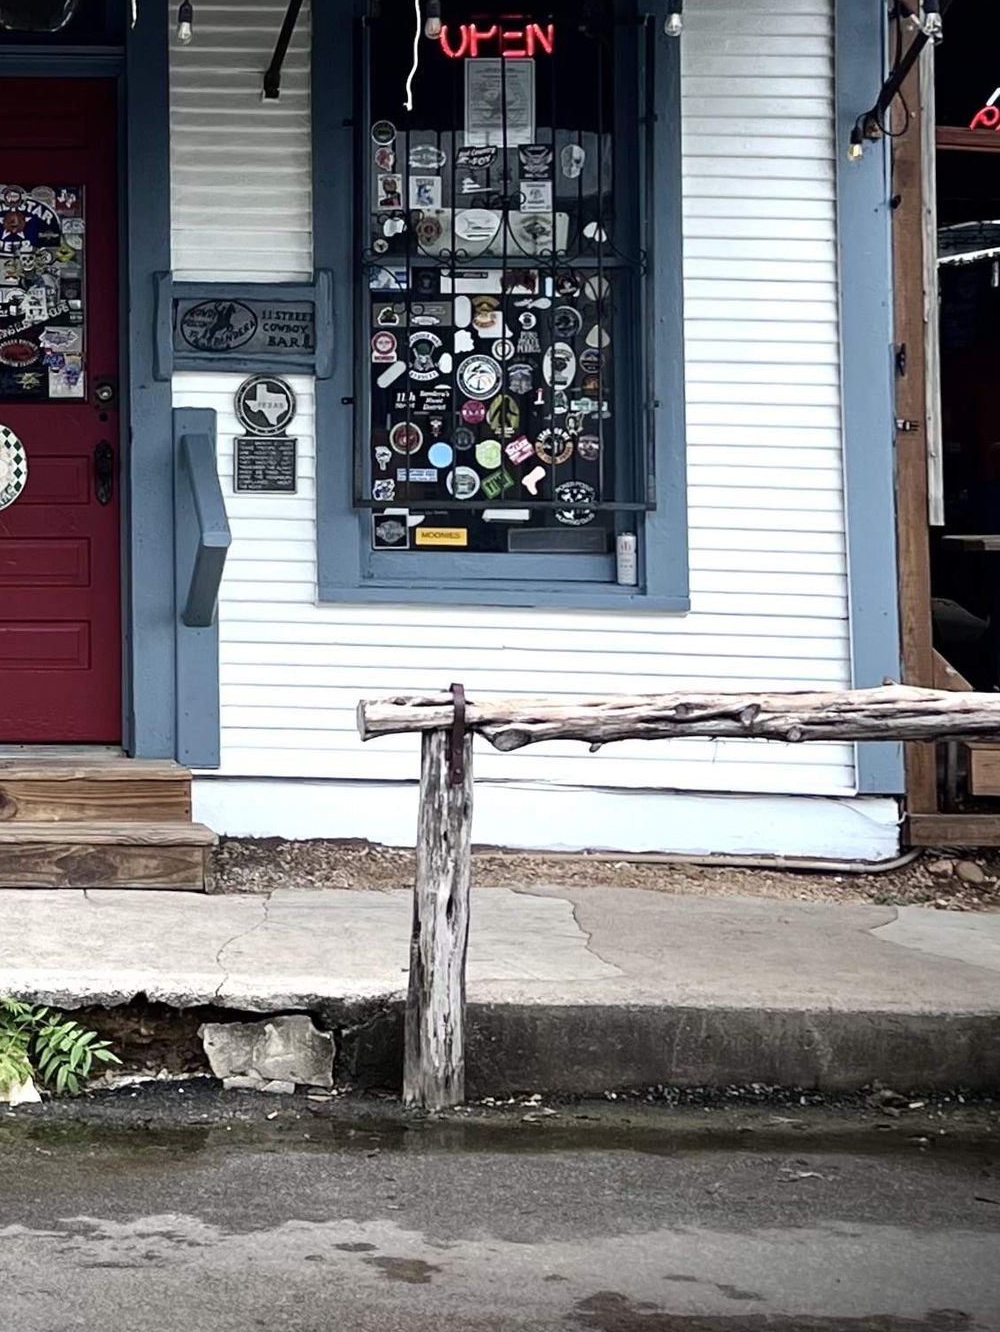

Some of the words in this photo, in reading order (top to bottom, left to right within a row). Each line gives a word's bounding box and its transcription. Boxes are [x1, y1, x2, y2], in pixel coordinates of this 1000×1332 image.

[440, 22, 555, 58] OPEN
[262, 322, 309, 334] COWBOY
[266, 335, 302, 349] BAR
[257, 401, 284, 409] TEXAS
